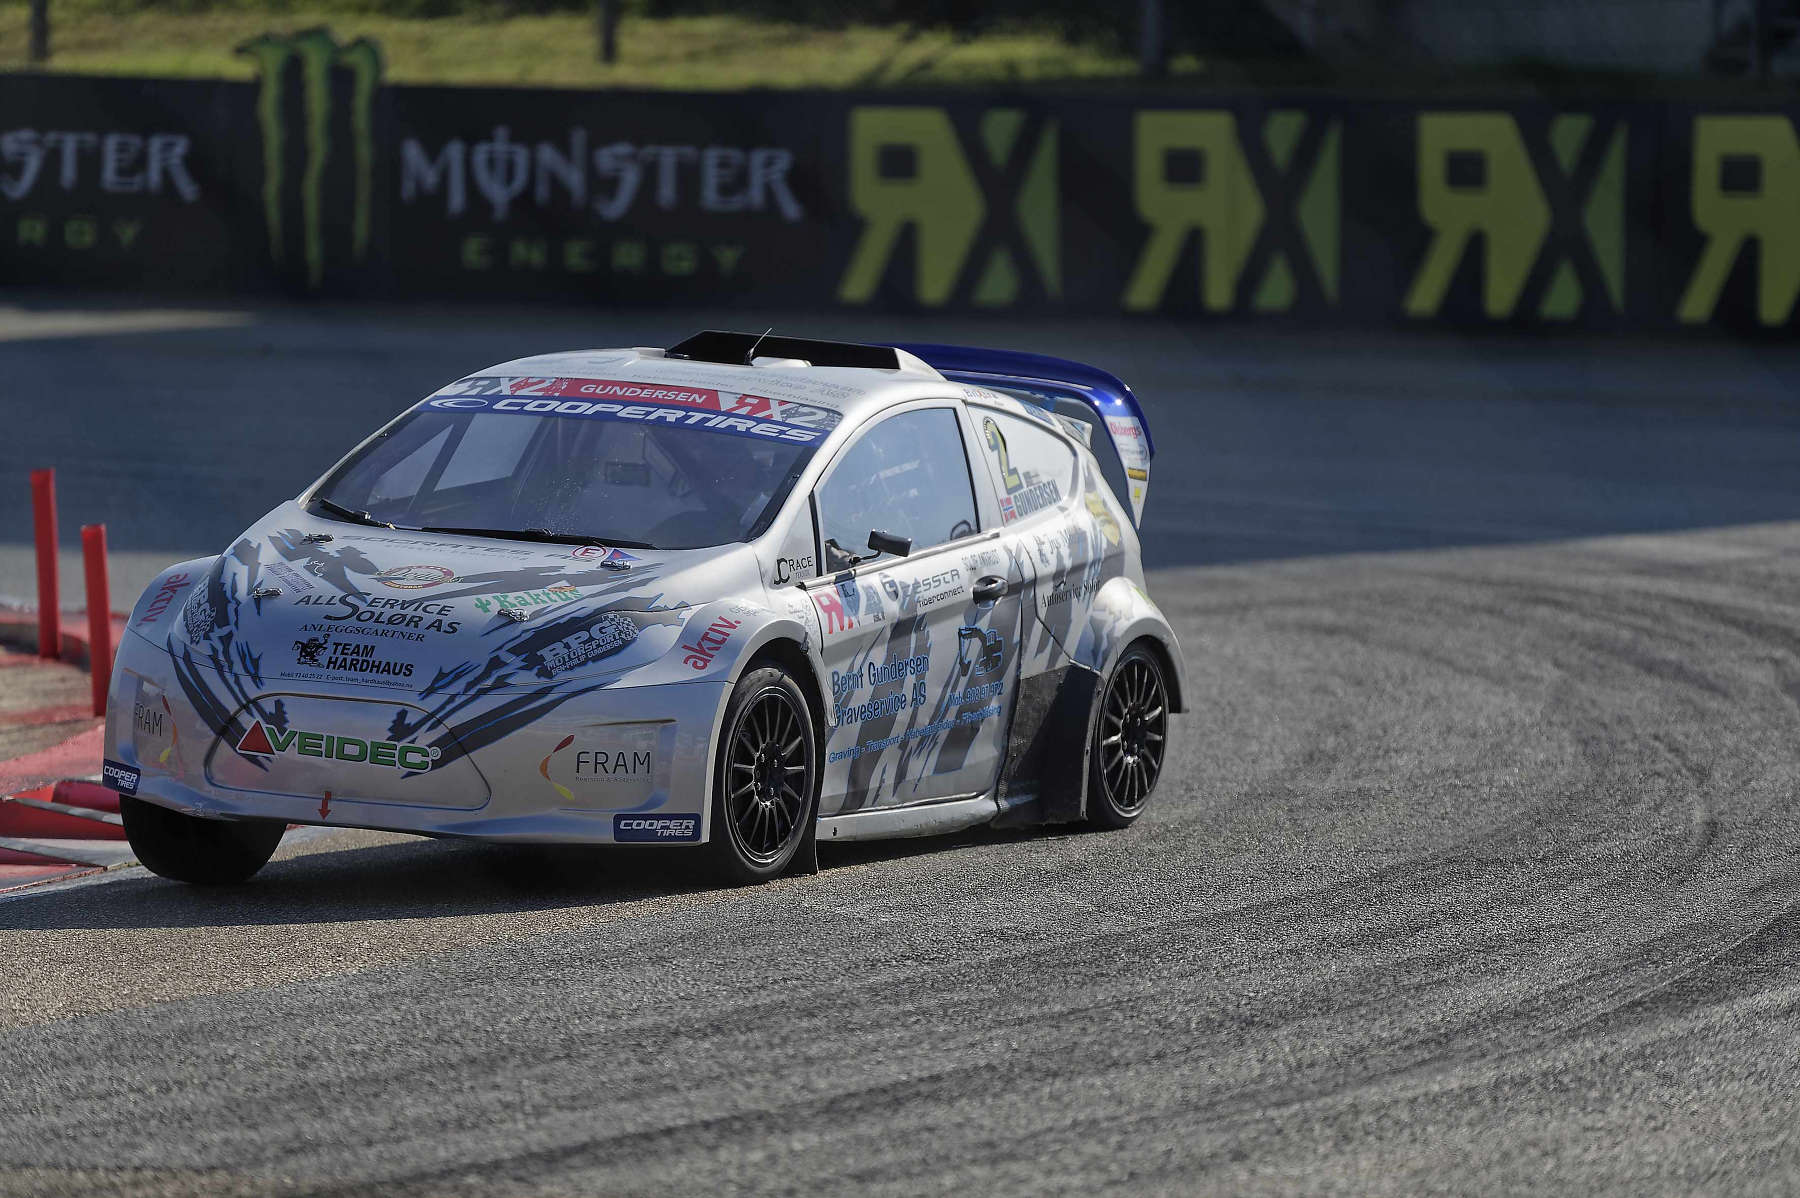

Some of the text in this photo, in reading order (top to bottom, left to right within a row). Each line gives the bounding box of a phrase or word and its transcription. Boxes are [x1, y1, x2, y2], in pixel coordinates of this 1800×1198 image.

[403, 126, 802, 222] MONSTER
[462, 237, 744, 275] ENERGY
[580, 383, 707, 403] GUNDERSEN
[982, 416, 1024, 496] 2
[1013, 480, 1062, 517] GUNDERSEN
[788, 556, 813, 572] RACE
[499, 586, 584, 607] Kaktus
[299, 623, 425, 642] ANLEGGSGARTNER
[426, 617, 462, 635] AS
[332, 641, 376, 658] TEAM
[544, 632, 621, 671] MOTORSPORT
[587, 639, 623, 658] GUNDERSEN
[325, 656, 414, 678] HARDHAUS
[831, 653, 930, 696] Bernt Gundersen
[832, 682, 927, 729] Graveservice AS
[134, 702, 164, 737] FRAM
[267, 729, 430, 770] VEIDEC
[575, 751, 652, 775] FRAM
[104, 765, 138, 783] COOPER
[117, 779, 135, 790] TIRES
[619, 819, 695, 831] COOPER
[655, 829, 693, 837] TIRES
